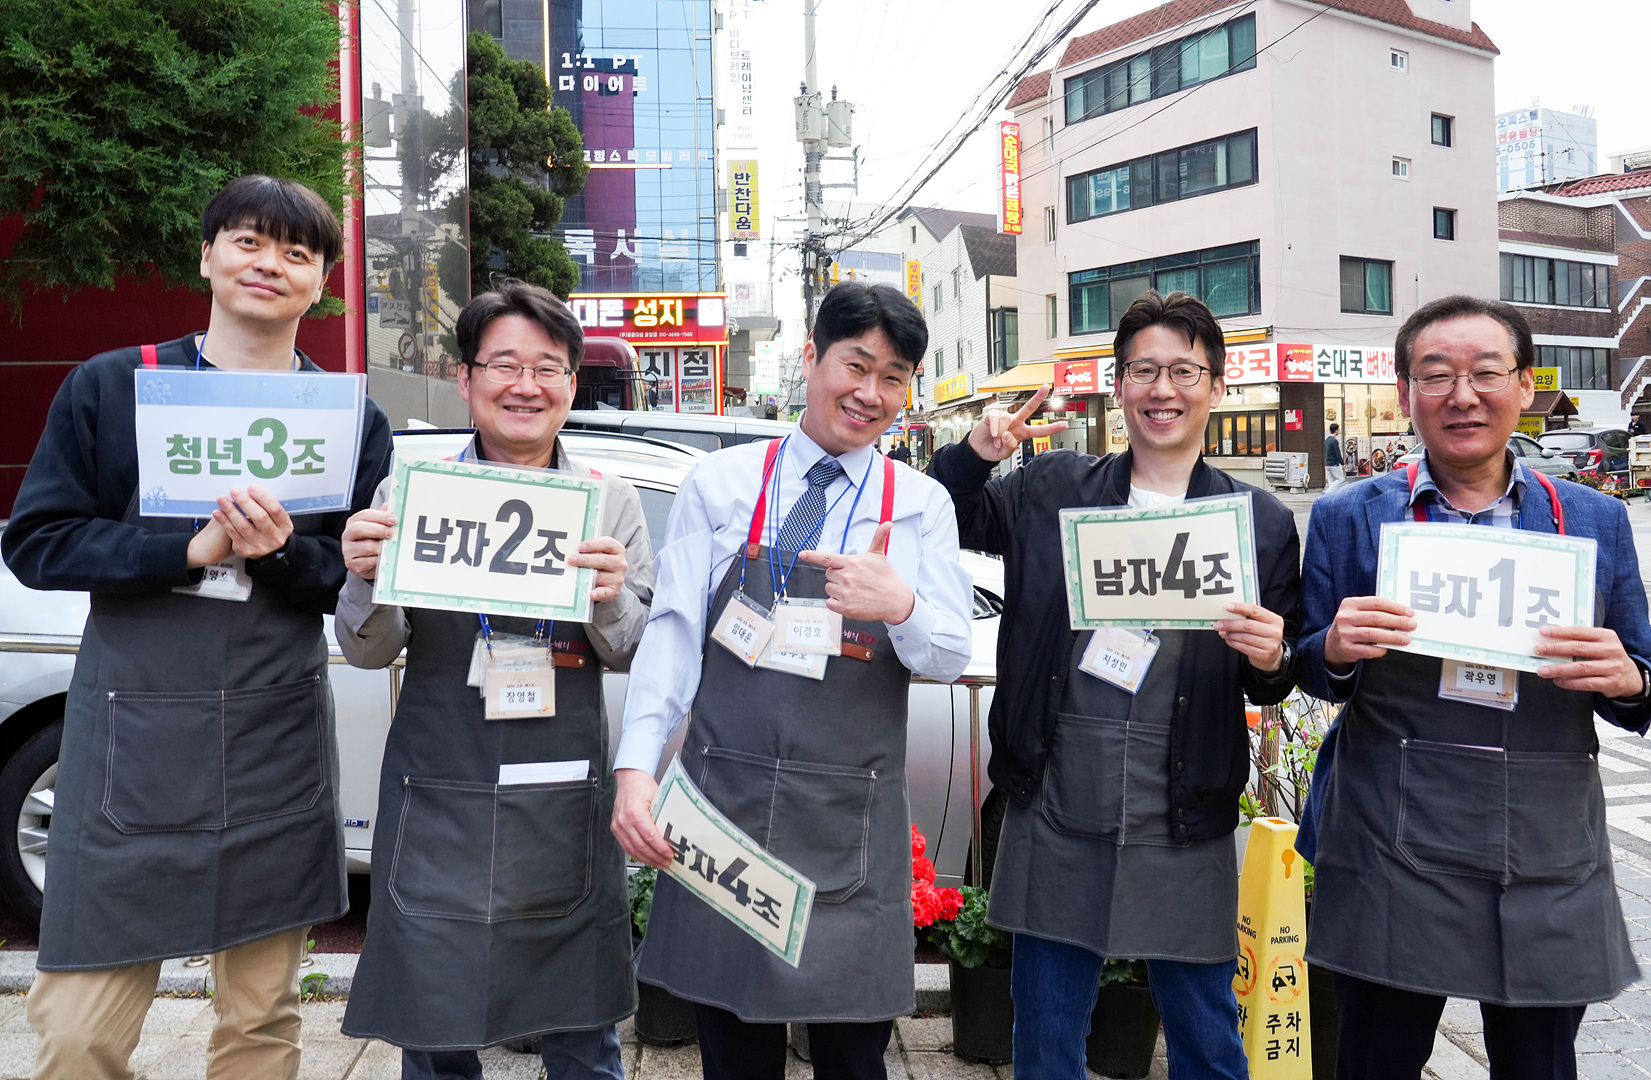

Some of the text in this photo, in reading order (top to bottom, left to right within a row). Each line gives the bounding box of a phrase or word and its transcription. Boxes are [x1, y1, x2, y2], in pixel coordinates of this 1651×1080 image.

[561, 53, 643, 69] 1:1 PT
[559, 75, 648, 92] 다이어트
[1003, 135, 1019, 173] 순대국
[734, 172, 752, 230] 반찬다움
[562, 299, 683, 327] 대폰 성지
[1226, 348, 1271, 380] 장국
[1317, 348, 1363, 378] 순대국
[1367, 351, 1394, 379] 뼈해
[1532, 373, 1553, 385] 요양
[166, 418, 326, 479] 청년3조
[413, 498, 568, 576] 남자2조
[1093, 532, 1235, 599] 남자4조
[1410, 558, 1561, 630] 남자1조
[793, 625, 822, 638] 이경호
[1102, 653, 1128, 673] 지성인
[1464, 670, 1496, 686] 곽우영
[506, 691, 536, 703] 장영철
[663, 822, 782, 929] 남자4조
[1237, 922, 1257, 939] ARKING
[1241, 914, 1251, 926] NO
[1280, 926, 1290, 934] NO
[1270, 935, 1299, 944] PARKING
[1266, 1011, 1301, 1035] 주차
[1265, 1036, 1300, 1061] 금지
